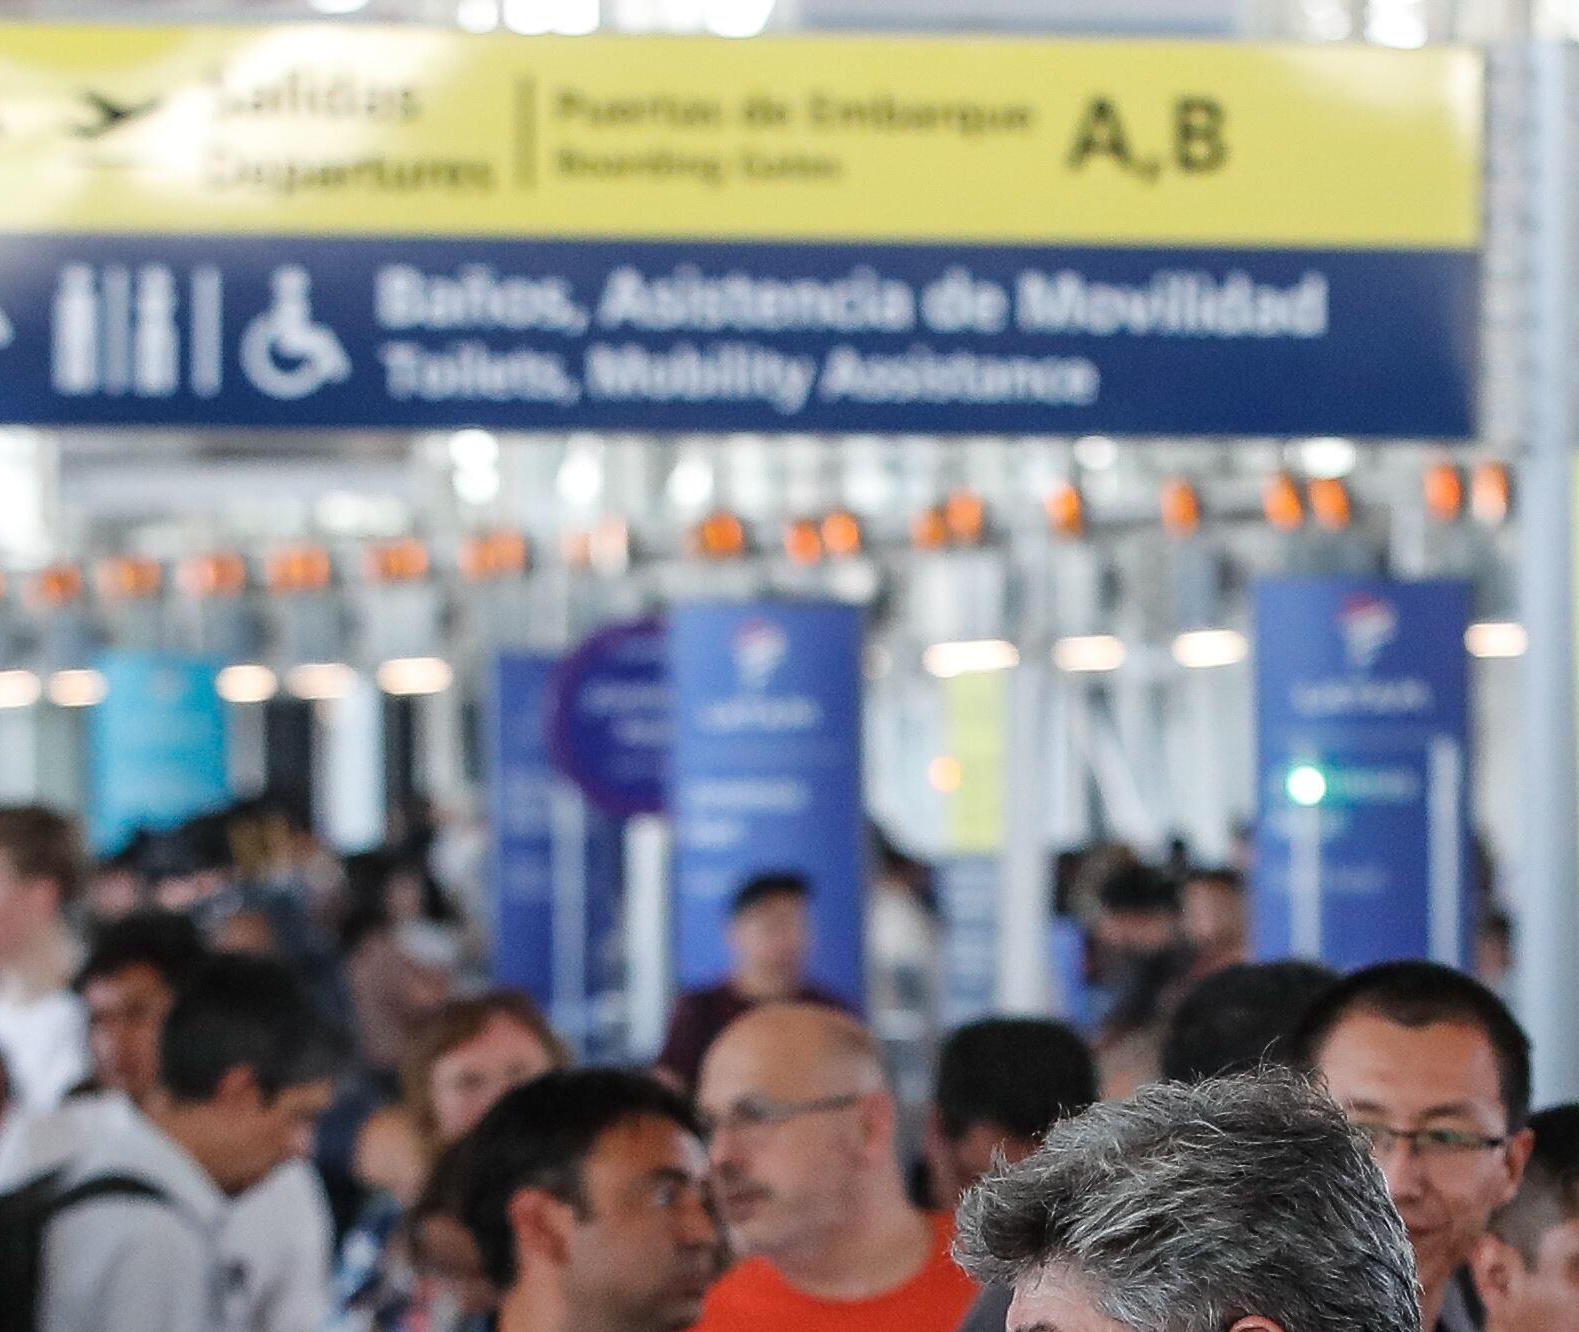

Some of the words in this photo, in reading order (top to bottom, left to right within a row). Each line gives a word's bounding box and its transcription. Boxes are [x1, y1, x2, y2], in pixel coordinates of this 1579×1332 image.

[1065, 94, 1229, 185] A,B
[373, 264, 589, 335] Baños,
[596, 265, 915, 334] Asistencia
[921, 266, 1008, 334] de
[1017, 269, 1328, 339] Movilidad
[376, 342, 583, 406] Toilets,
[584, 345, 819, 414] Mobility
[820, 347, 1102, 406] Assistance
